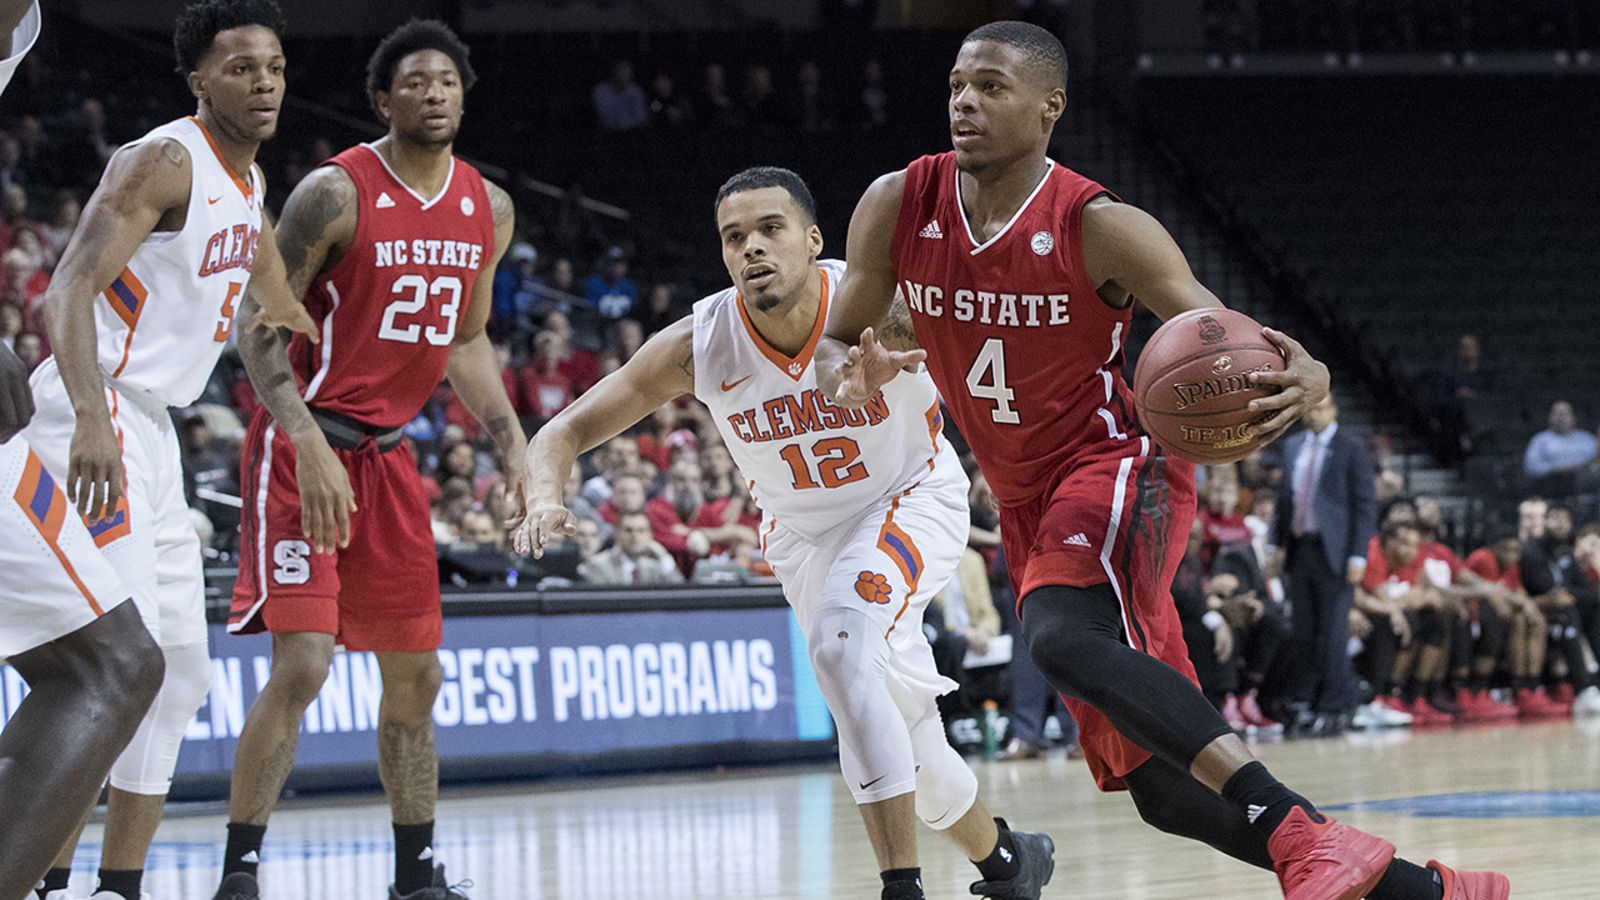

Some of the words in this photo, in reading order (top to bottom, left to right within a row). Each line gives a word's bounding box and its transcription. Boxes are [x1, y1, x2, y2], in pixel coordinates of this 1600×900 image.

[375, 240, 408, 268] NC
[412, 239, 482, 270] STATE
[214, 281, 242, 342] 5
[378, 275, 463, 346] 23
[905, 280, 944, 317] NC
[954, 289, 1070, 326] STATE
[966, 338, 1020, 424] 4
[1173, 363, 1273, 412] SPALDI
[780, 436, 870, 490] 12
[550, 638, 778, 723] PROGRAMS
